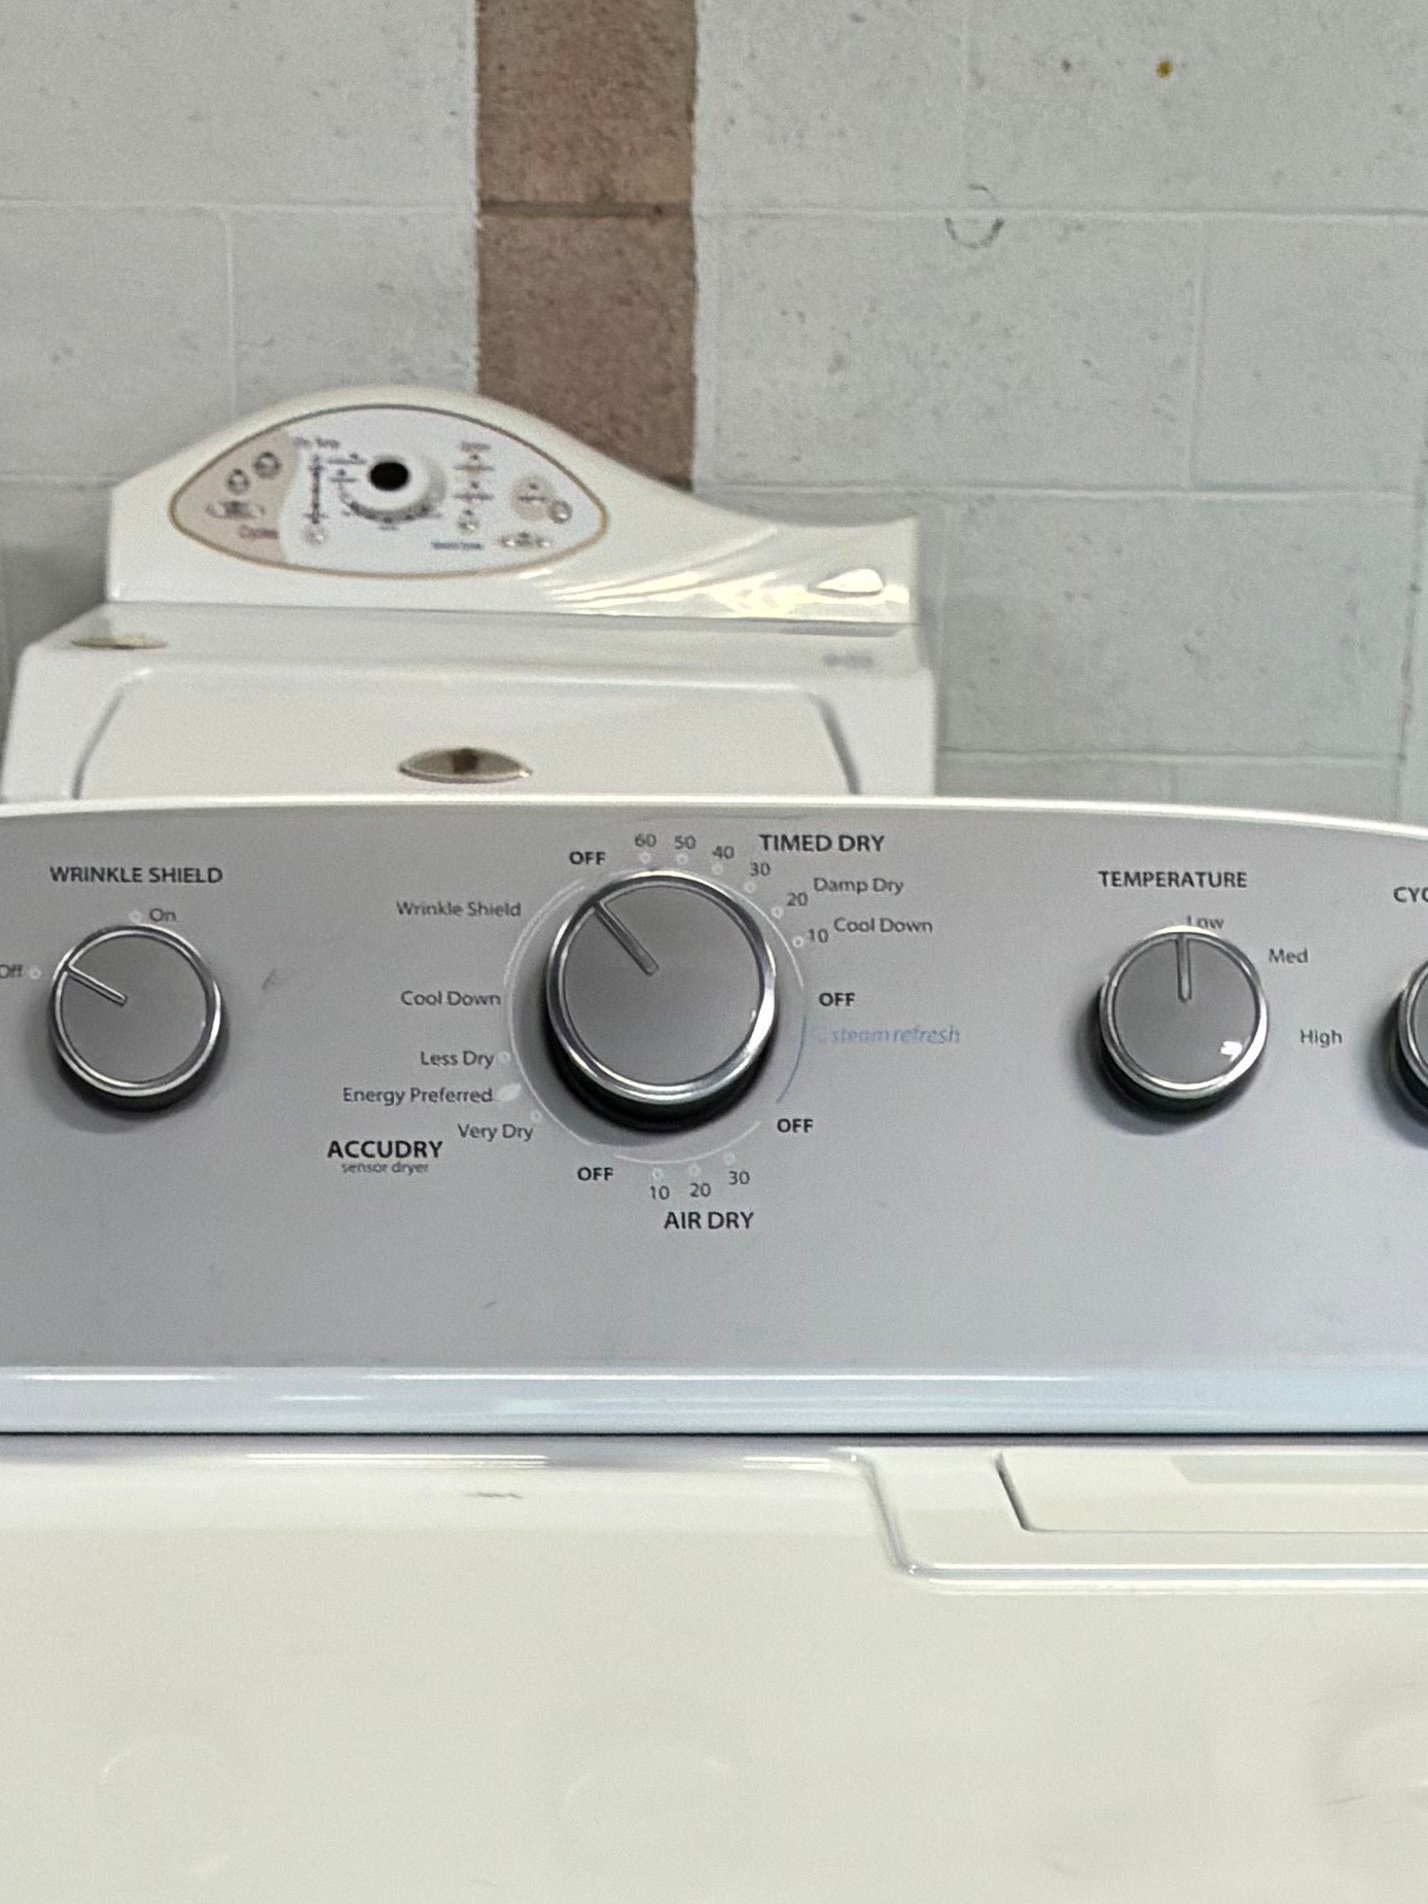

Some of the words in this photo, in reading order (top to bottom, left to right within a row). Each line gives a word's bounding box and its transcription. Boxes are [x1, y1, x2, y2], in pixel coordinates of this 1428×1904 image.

[634, 834, 657, 848] 60
[674, 835, 697, 850] 50
[759, 834, 832, 852] TIMED
[838, 834, 885, 852] DRY
[569, 851, 606, 866] OFF
[712, 846, 735, 860] 40
[49, 866, 143, 883] WRINKLE
[149, 867, 223, 883] SHIELD
[749, 862, 771, 877] 30
[814, 877, 868, 896] Damp
[873, 877, 904, 895] Dry
[1099, 871, 1248, 888] TEMPERATURE
[786, 893, 808, 907] 20
[149, 907, 177, 923] On
[397, 901, 463, 917] Wrinkle
[468, 902, 521, 917] Shield
[833, 916, 875, 933] Cool
[880, 917, 933, 934] Down
[808, 929, 829, 943] 10
[1268, 948, 1309, 964] Med
[401, 990, 443, 1006] Cool
[447, 991, 501, 1006] Down
[818, 992, 855, 1007] OFF
[1300, 1029, 1343, 1047] High
[421, 1051, 458, 1066] Less
[463, 1051, 495, 1069] Dry
[343, 1087, 405, 1106] Energy
[410, 1087, 493, 1103] Preferred
[458, 1124, 498, 1142] Very
[502, 1124, 534, 1142] Dry
[776, 1118, 814, 1133] OFF
[327, 1140, 443, 1158] ACCUDRY
[342, 1162, 387, 1173] sensor
[391, 1161, 429, 1176] dryer
[577, 1167, 614, 1181] OFF
[728, 1171, 750, 1186] 30
[650, 1185, 670, 1200] 10
[689, 1183, 711, 1197] 20
[663, 1211, 702, 1230] AIR
[708, 1211, 754, 1230] DRY
